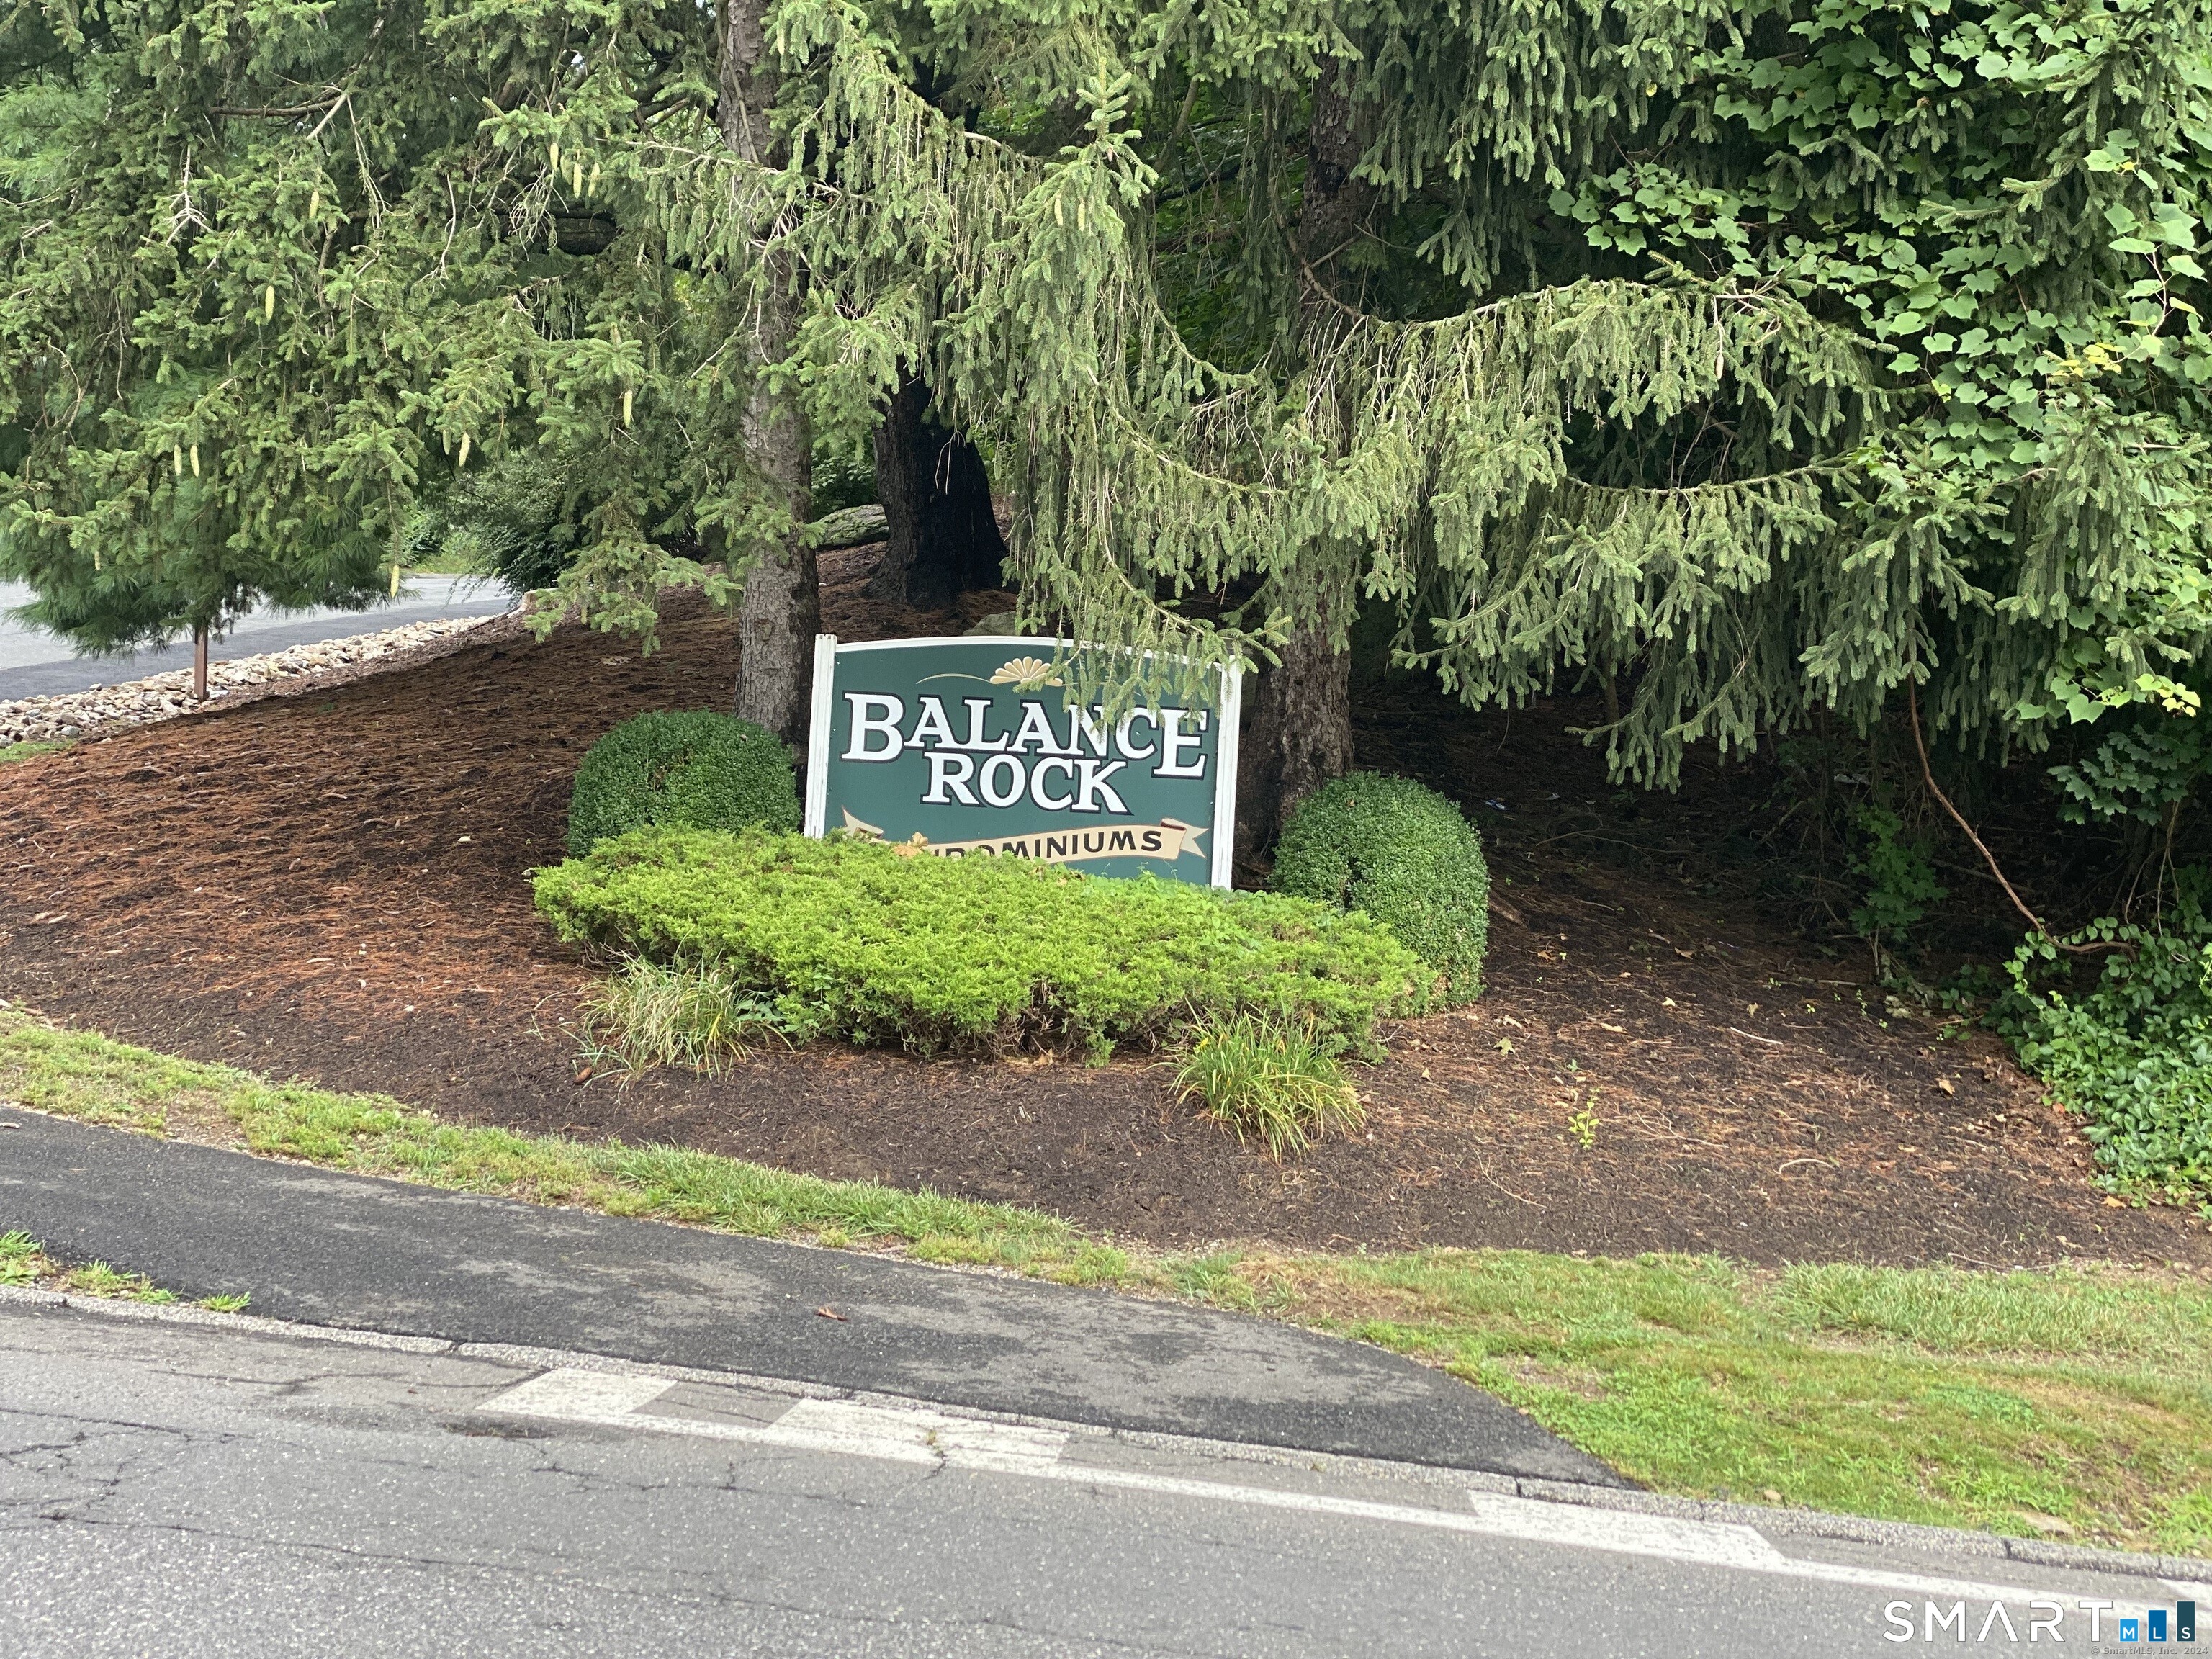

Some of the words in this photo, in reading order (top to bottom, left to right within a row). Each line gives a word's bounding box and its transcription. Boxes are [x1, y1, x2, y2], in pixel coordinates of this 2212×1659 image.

[841, 691, 1208, 779] BALANCE
[920, 752, 1133, 815] ROCK
[934, 830, 1163, 861] MINIUMS
